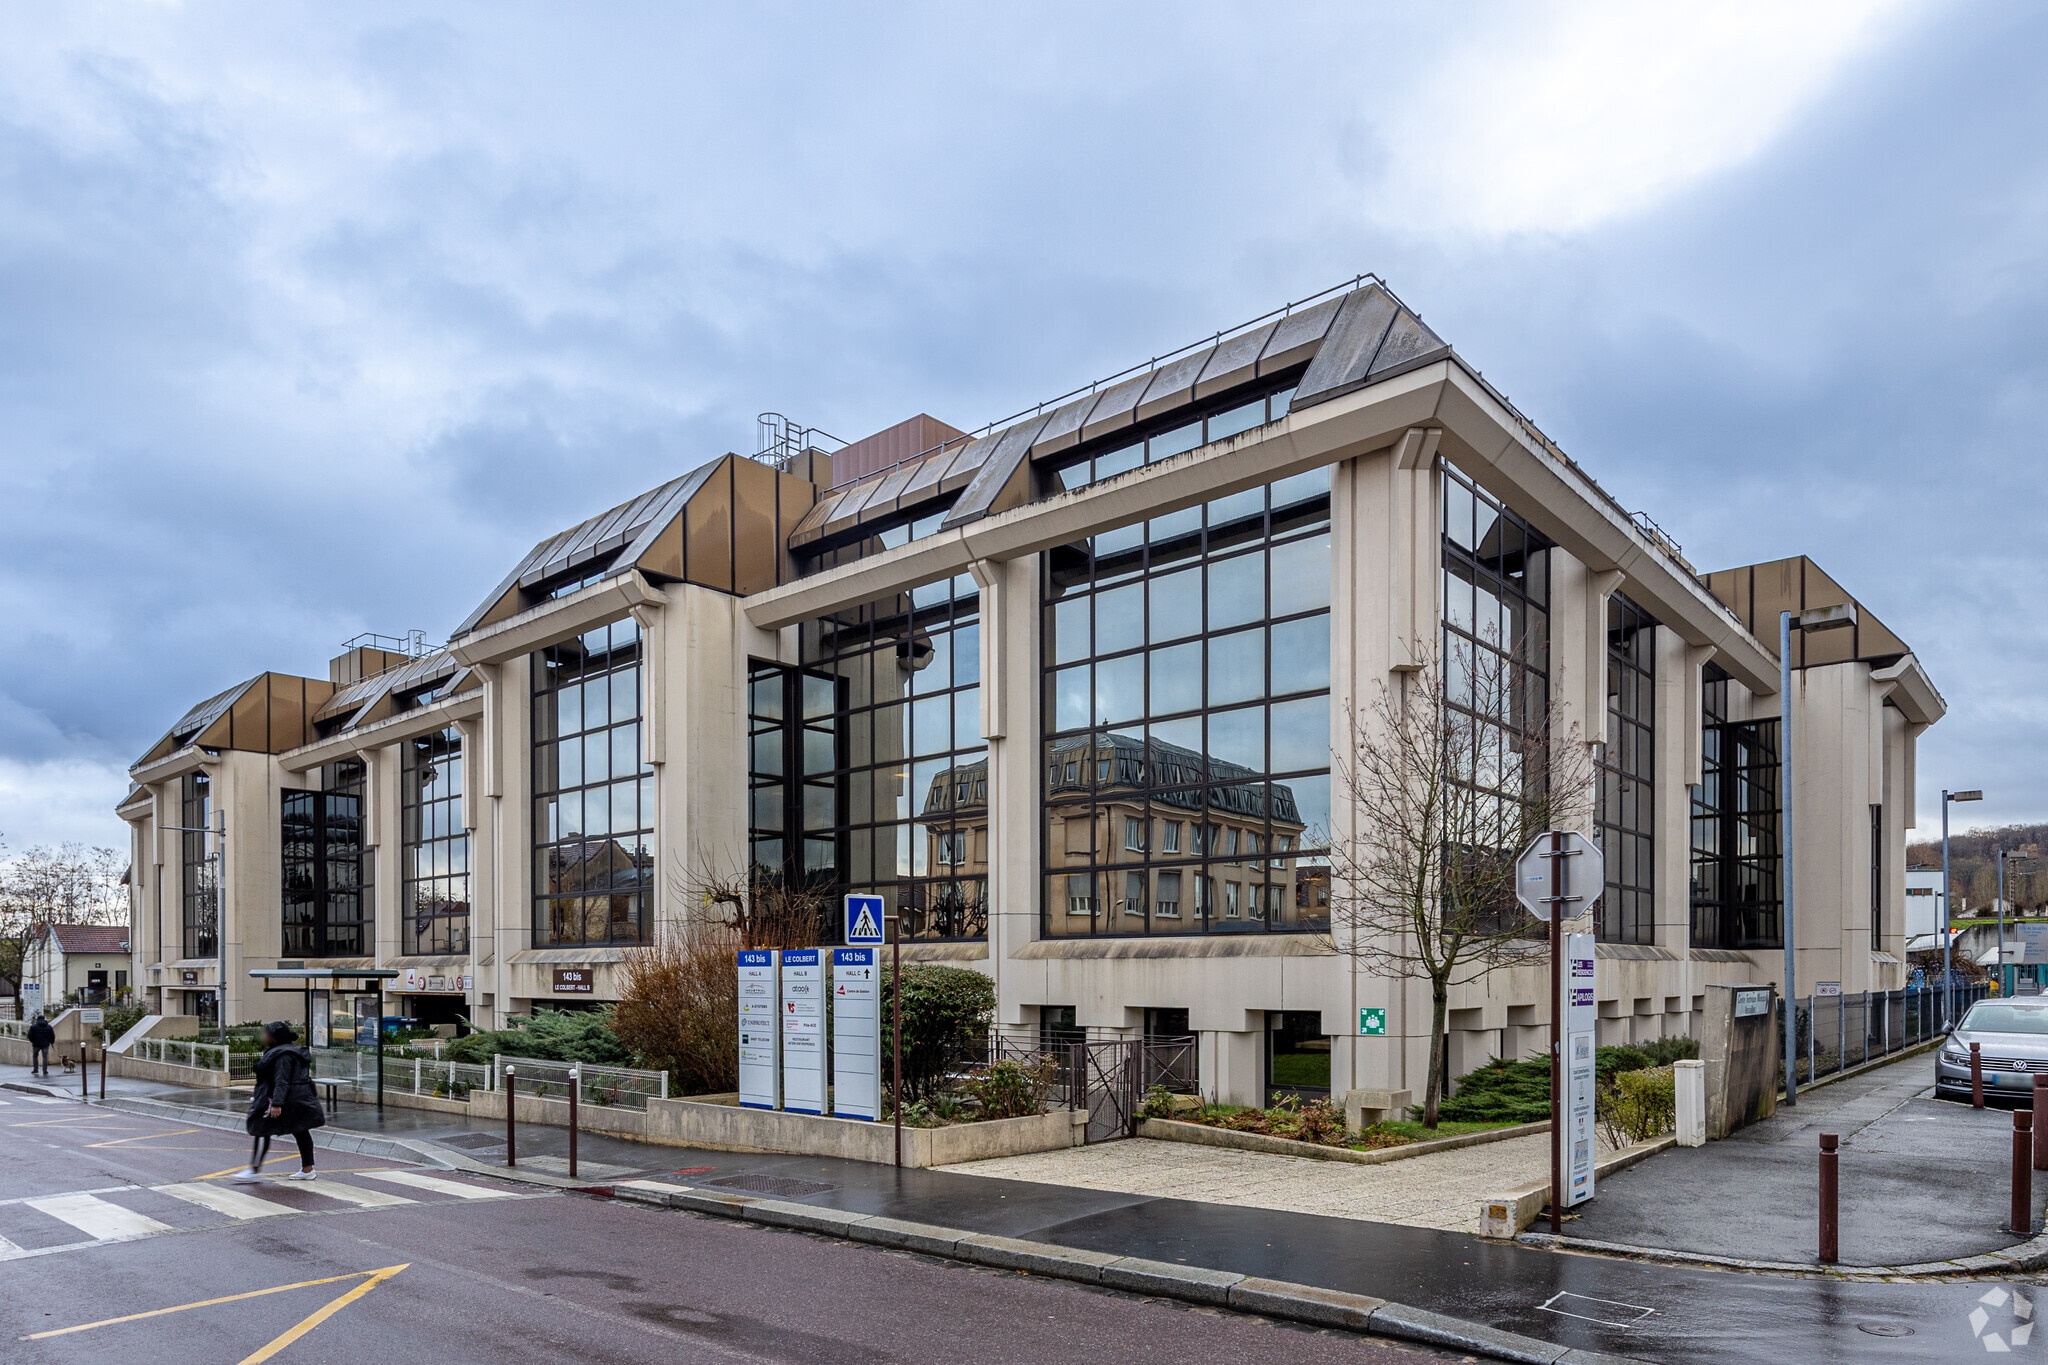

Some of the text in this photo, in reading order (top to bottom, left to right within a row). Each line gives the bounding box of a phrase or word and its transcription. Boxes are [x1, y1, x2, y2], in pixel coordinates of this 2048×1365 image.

[744, 954, 766, 963] 143 bis
[792, 955, 816, 963] COLBERT
[841, 952, 866, 962] 143 bis
[563, 972, 582, 981] 143 bis
